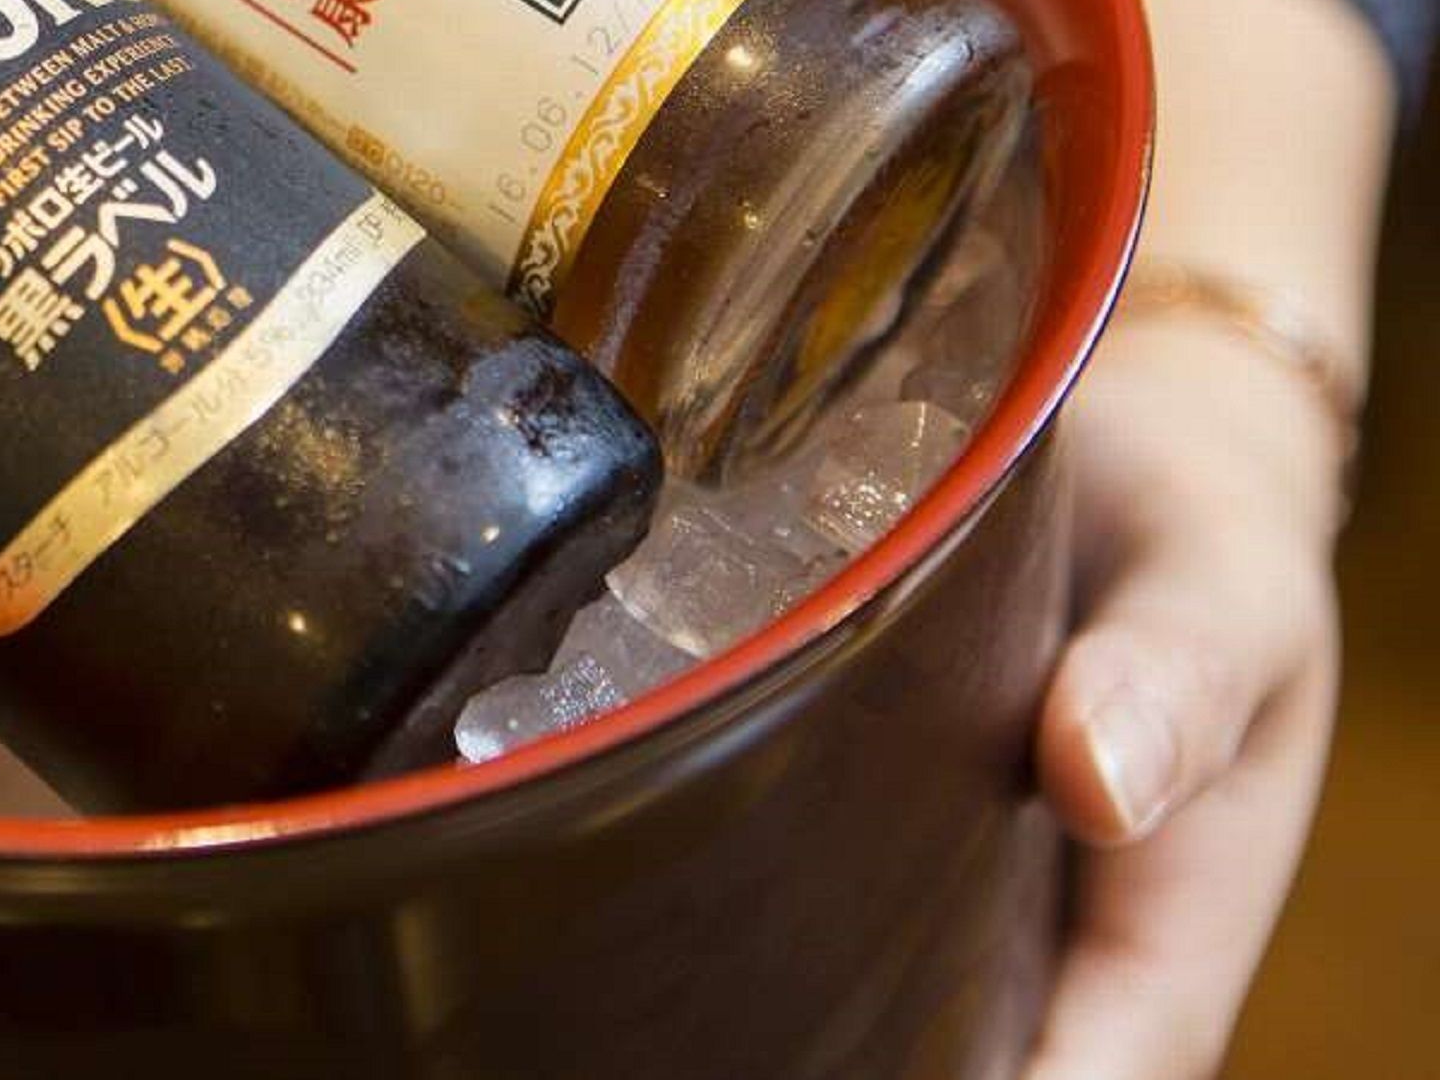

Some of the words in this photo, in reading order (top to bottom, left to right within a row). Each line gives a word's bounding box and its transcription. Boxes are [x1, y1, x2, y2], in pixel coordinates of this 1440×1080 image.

[70, 22, 122, 58] MALT
[47, 117, 85, 153] SIP
[82, 95, 116, 122] TO
[113, 71, 155, 103] THE
